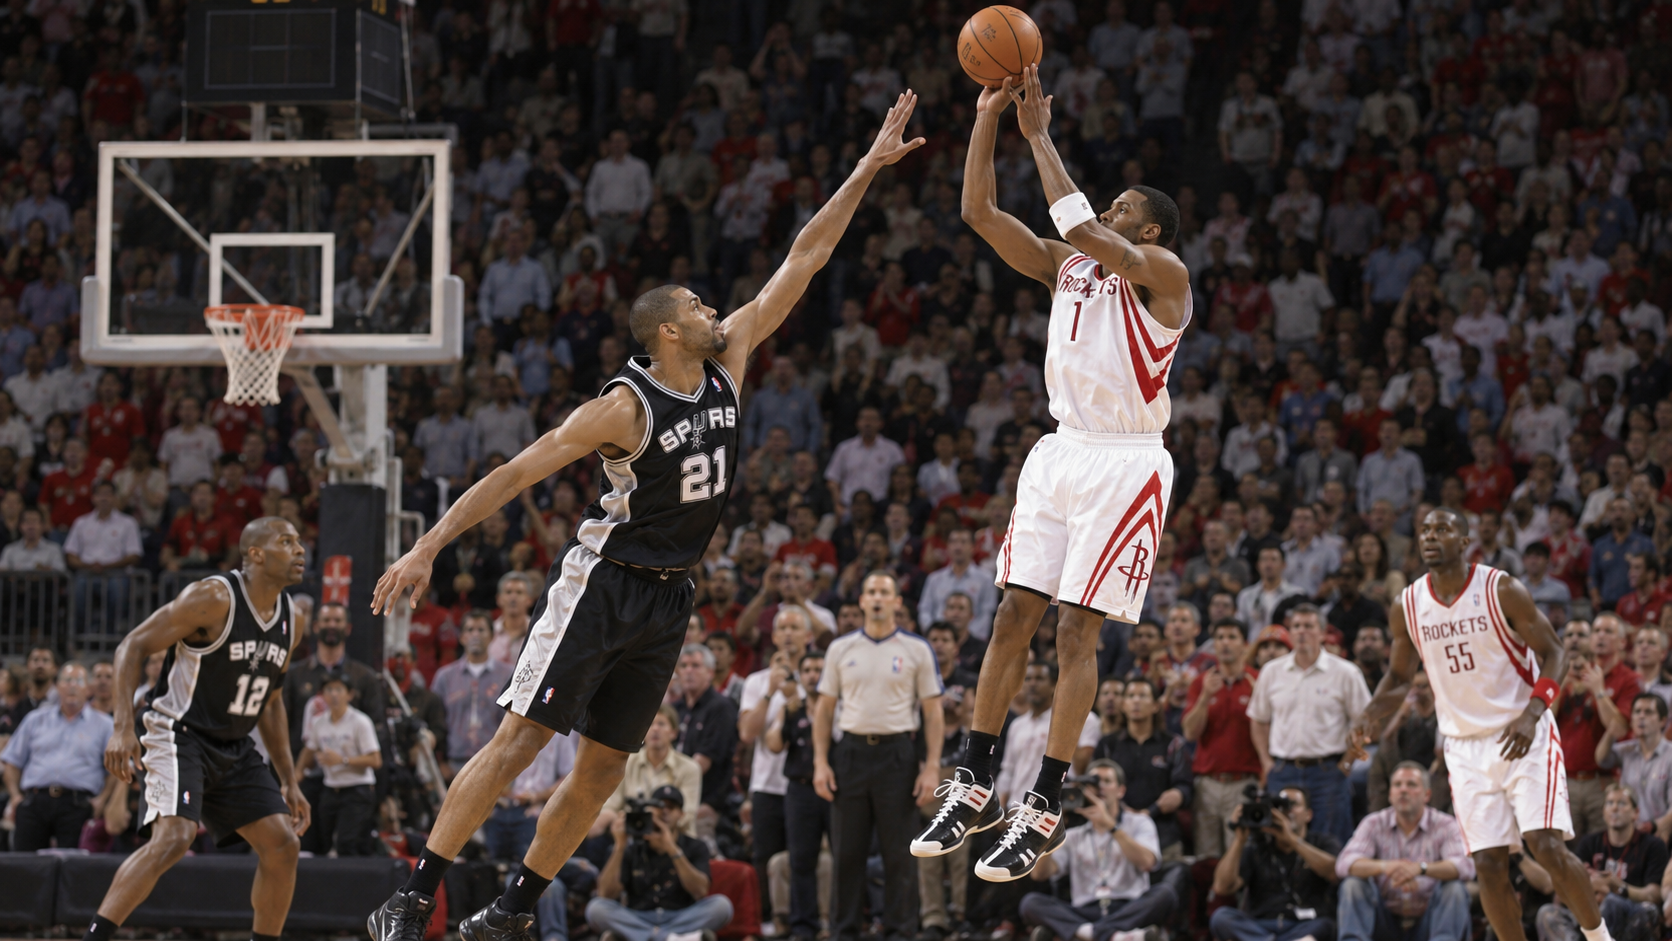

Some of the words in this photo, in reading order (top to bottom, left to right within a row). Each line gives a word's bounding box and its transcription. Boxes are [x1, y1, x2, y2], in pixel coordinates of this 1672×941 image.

[1070, 301, 1083, 342] 1
[657, 405, 736, 454] SPURS
[680, 445, 727, 504] 21
[1421, 615, 1489, 643] ROCKETS
[229, 639, 288, 672] SPURS
[1444, 641, 1476, 674] 55
[226, 673, 270, 717] 12
